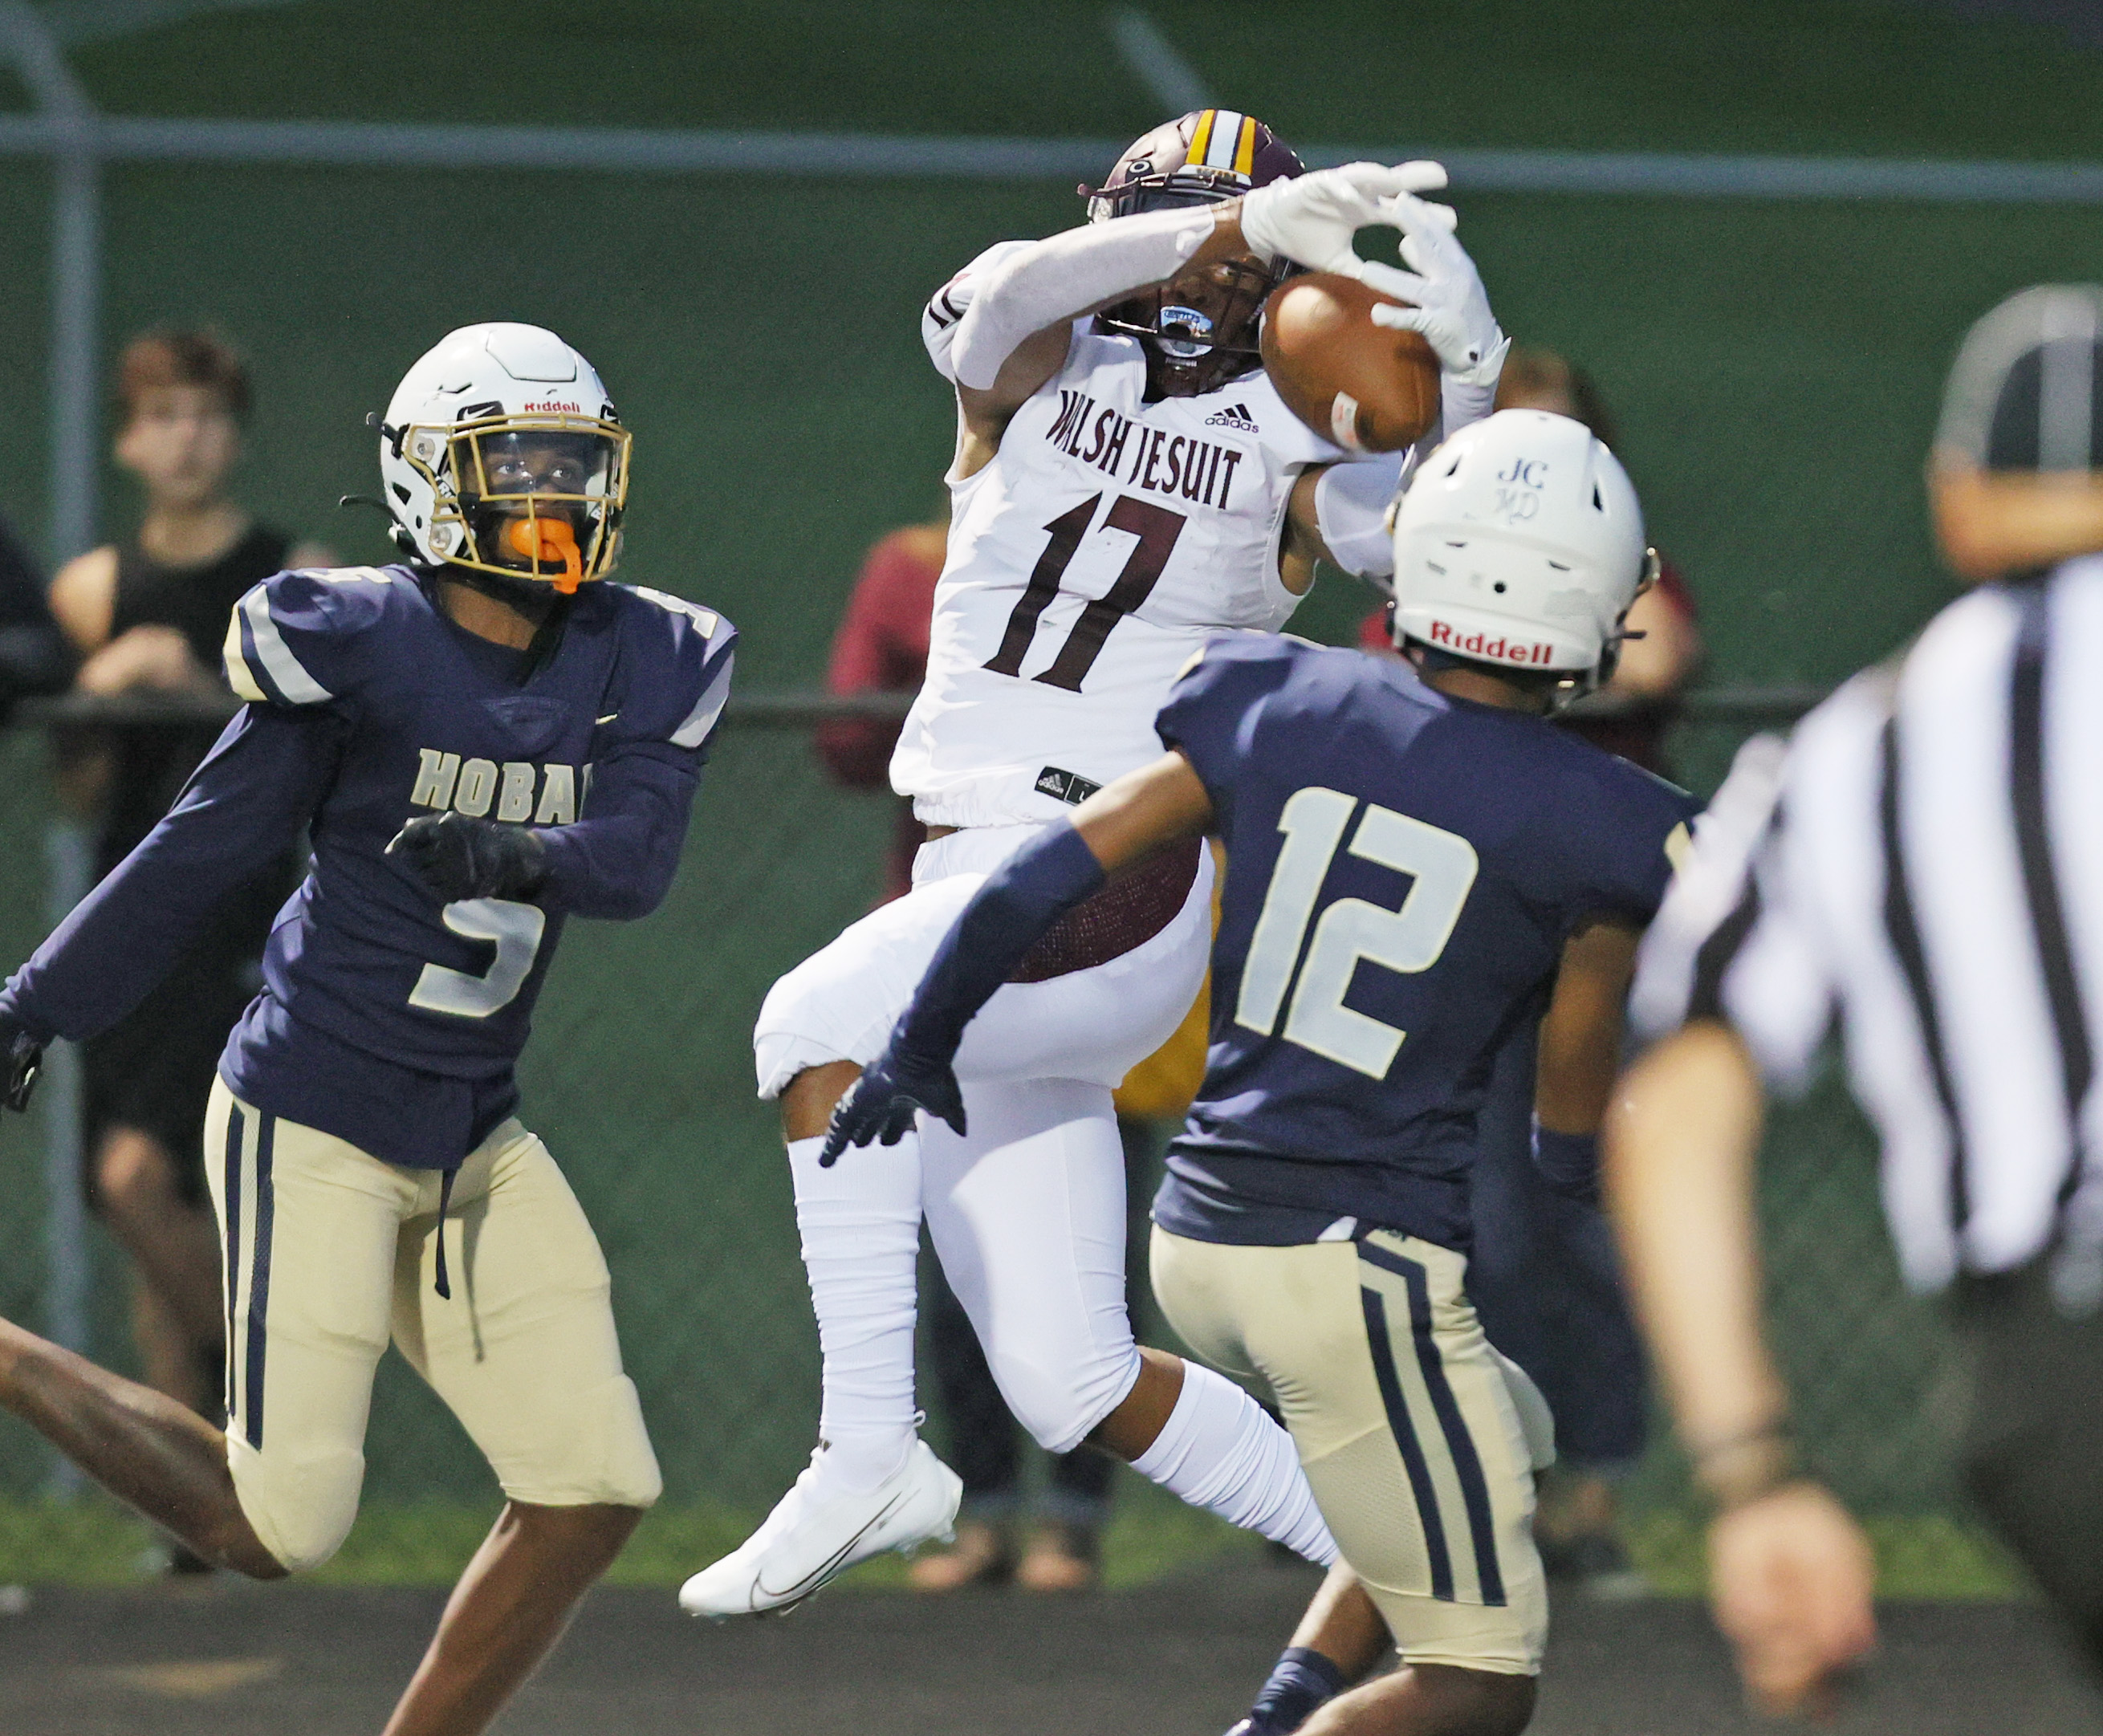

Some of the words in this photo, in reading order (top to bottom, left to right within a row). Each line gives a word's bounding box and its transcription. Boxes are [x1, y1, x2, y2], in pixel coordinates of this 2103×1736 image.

[1046, 390, 1133, 477] WALSH
[1127, 427, 1243, 510] JESUIT
[1205, 417, 1259, 433] adidas
[1498, 457, 1548, 489] JC
[981, 490, 1187, 693] 17
[1430, 620, 1552, 665] Riddell
[1235, 786, 1479, 1080] 12
